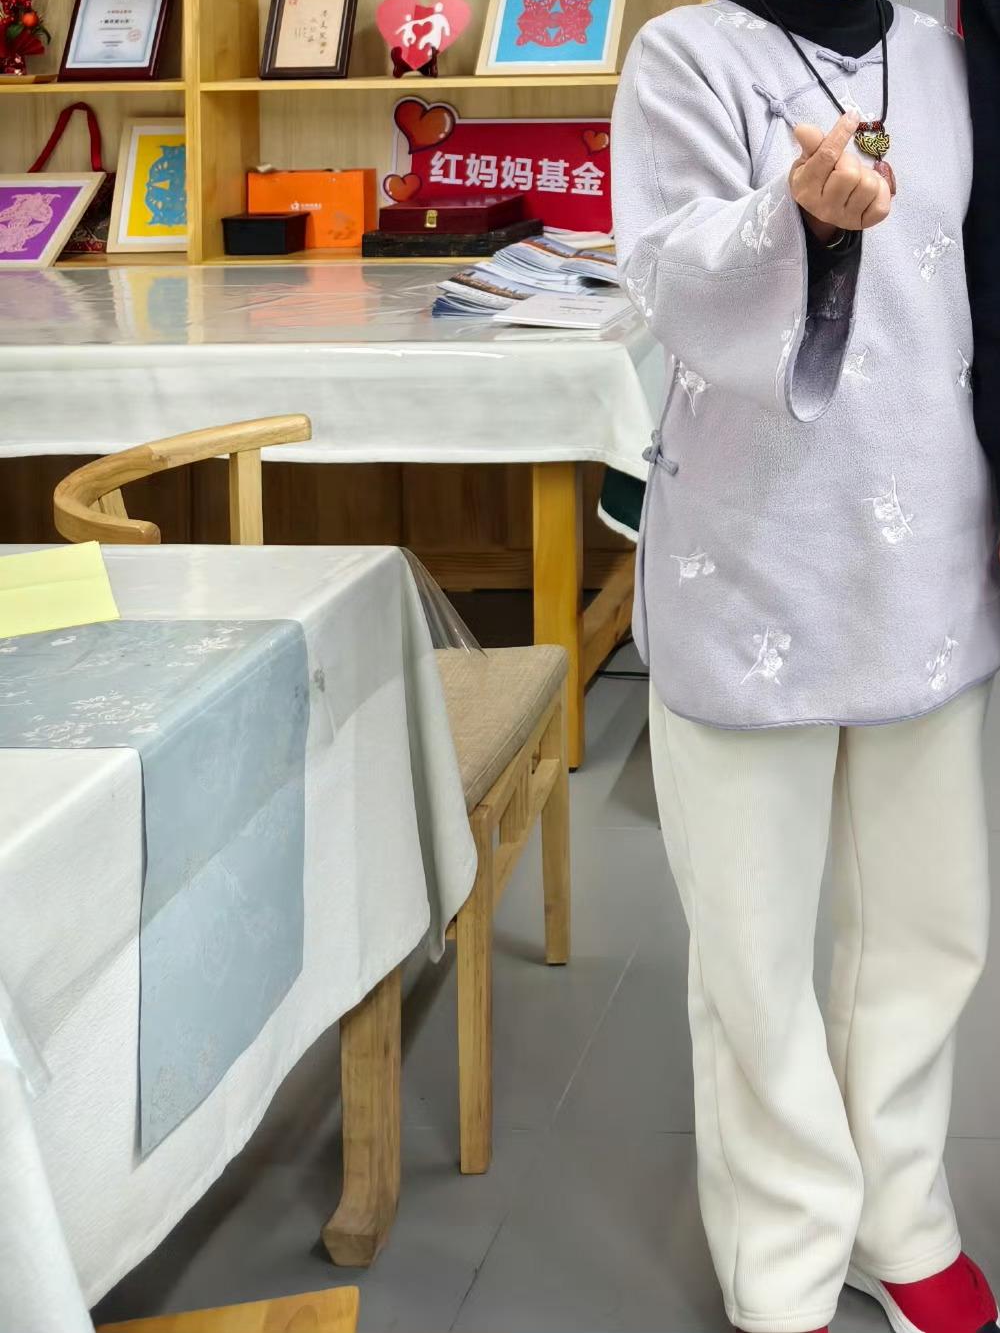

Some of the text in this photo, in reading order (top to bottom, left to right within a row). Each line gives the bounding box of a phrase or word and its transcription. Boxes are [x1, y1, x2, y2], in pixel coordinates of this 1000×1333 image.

[429, 150, 606, 196] 红妈妈基金
